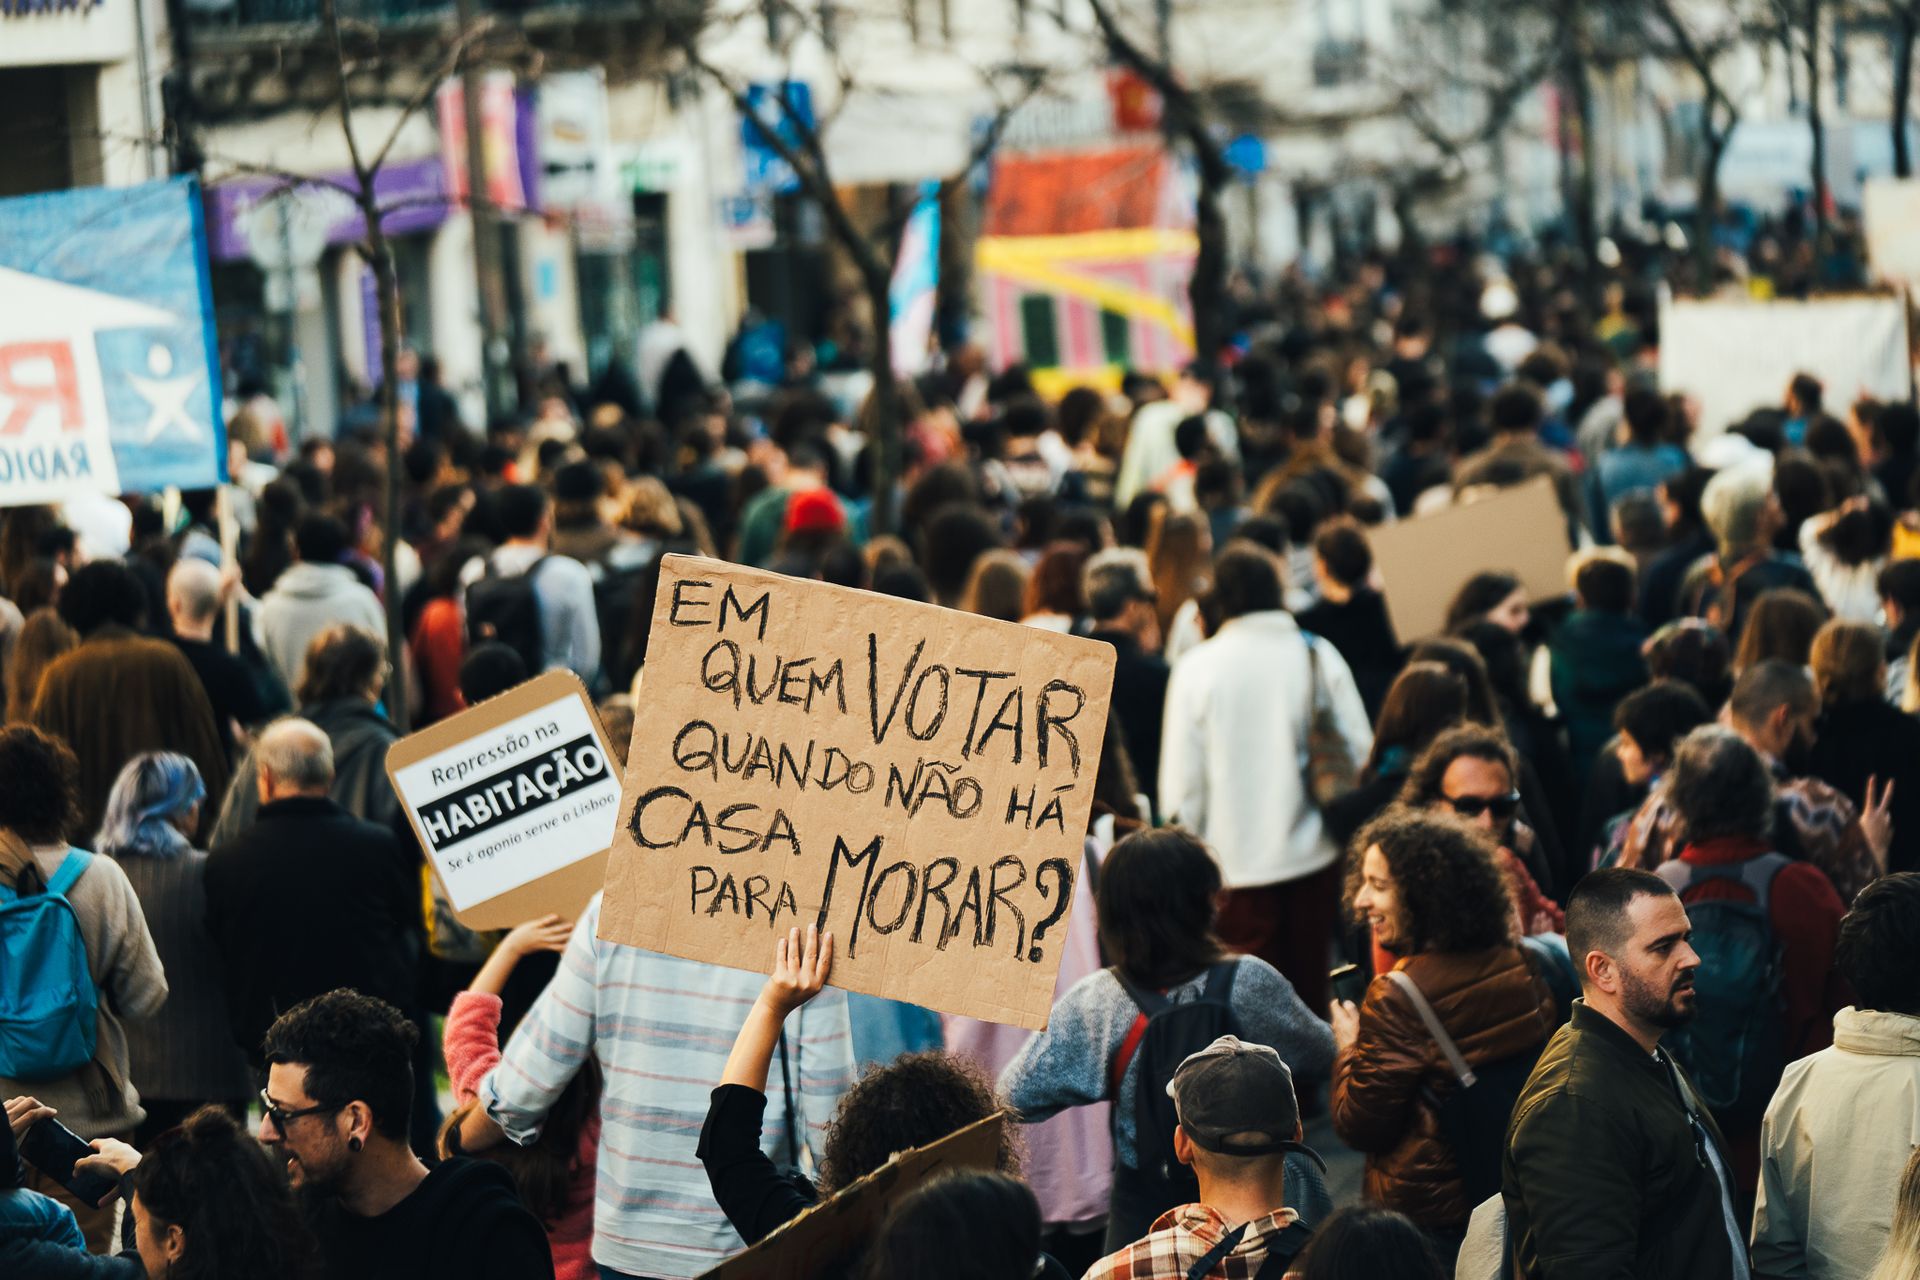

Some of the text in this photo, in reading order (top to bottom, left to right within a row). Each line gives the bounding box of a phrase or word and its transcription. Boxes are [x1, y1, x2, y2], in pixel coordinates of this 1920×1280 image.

[669, 580, 770, 642] EM
[700, 632, 1086, 779] QUEM VOTAR
[423, 745, 604, 844] HABITAÇÃO
[431, 720, 560, 786] Repressão na
[672, 719, 1075, 834] QUANDO NÃO HÁ
[448, 857, 464, 873] Se
[467, 851, 475, 863] é
[477, 833, 523, 858] agonia
[525, 817, 560, 837] serve
[573, 793, 616, 818] Lisboa
[627, 785, 802, 856] CASA
[688, 834, 1074, 963] PARA MORAR?
